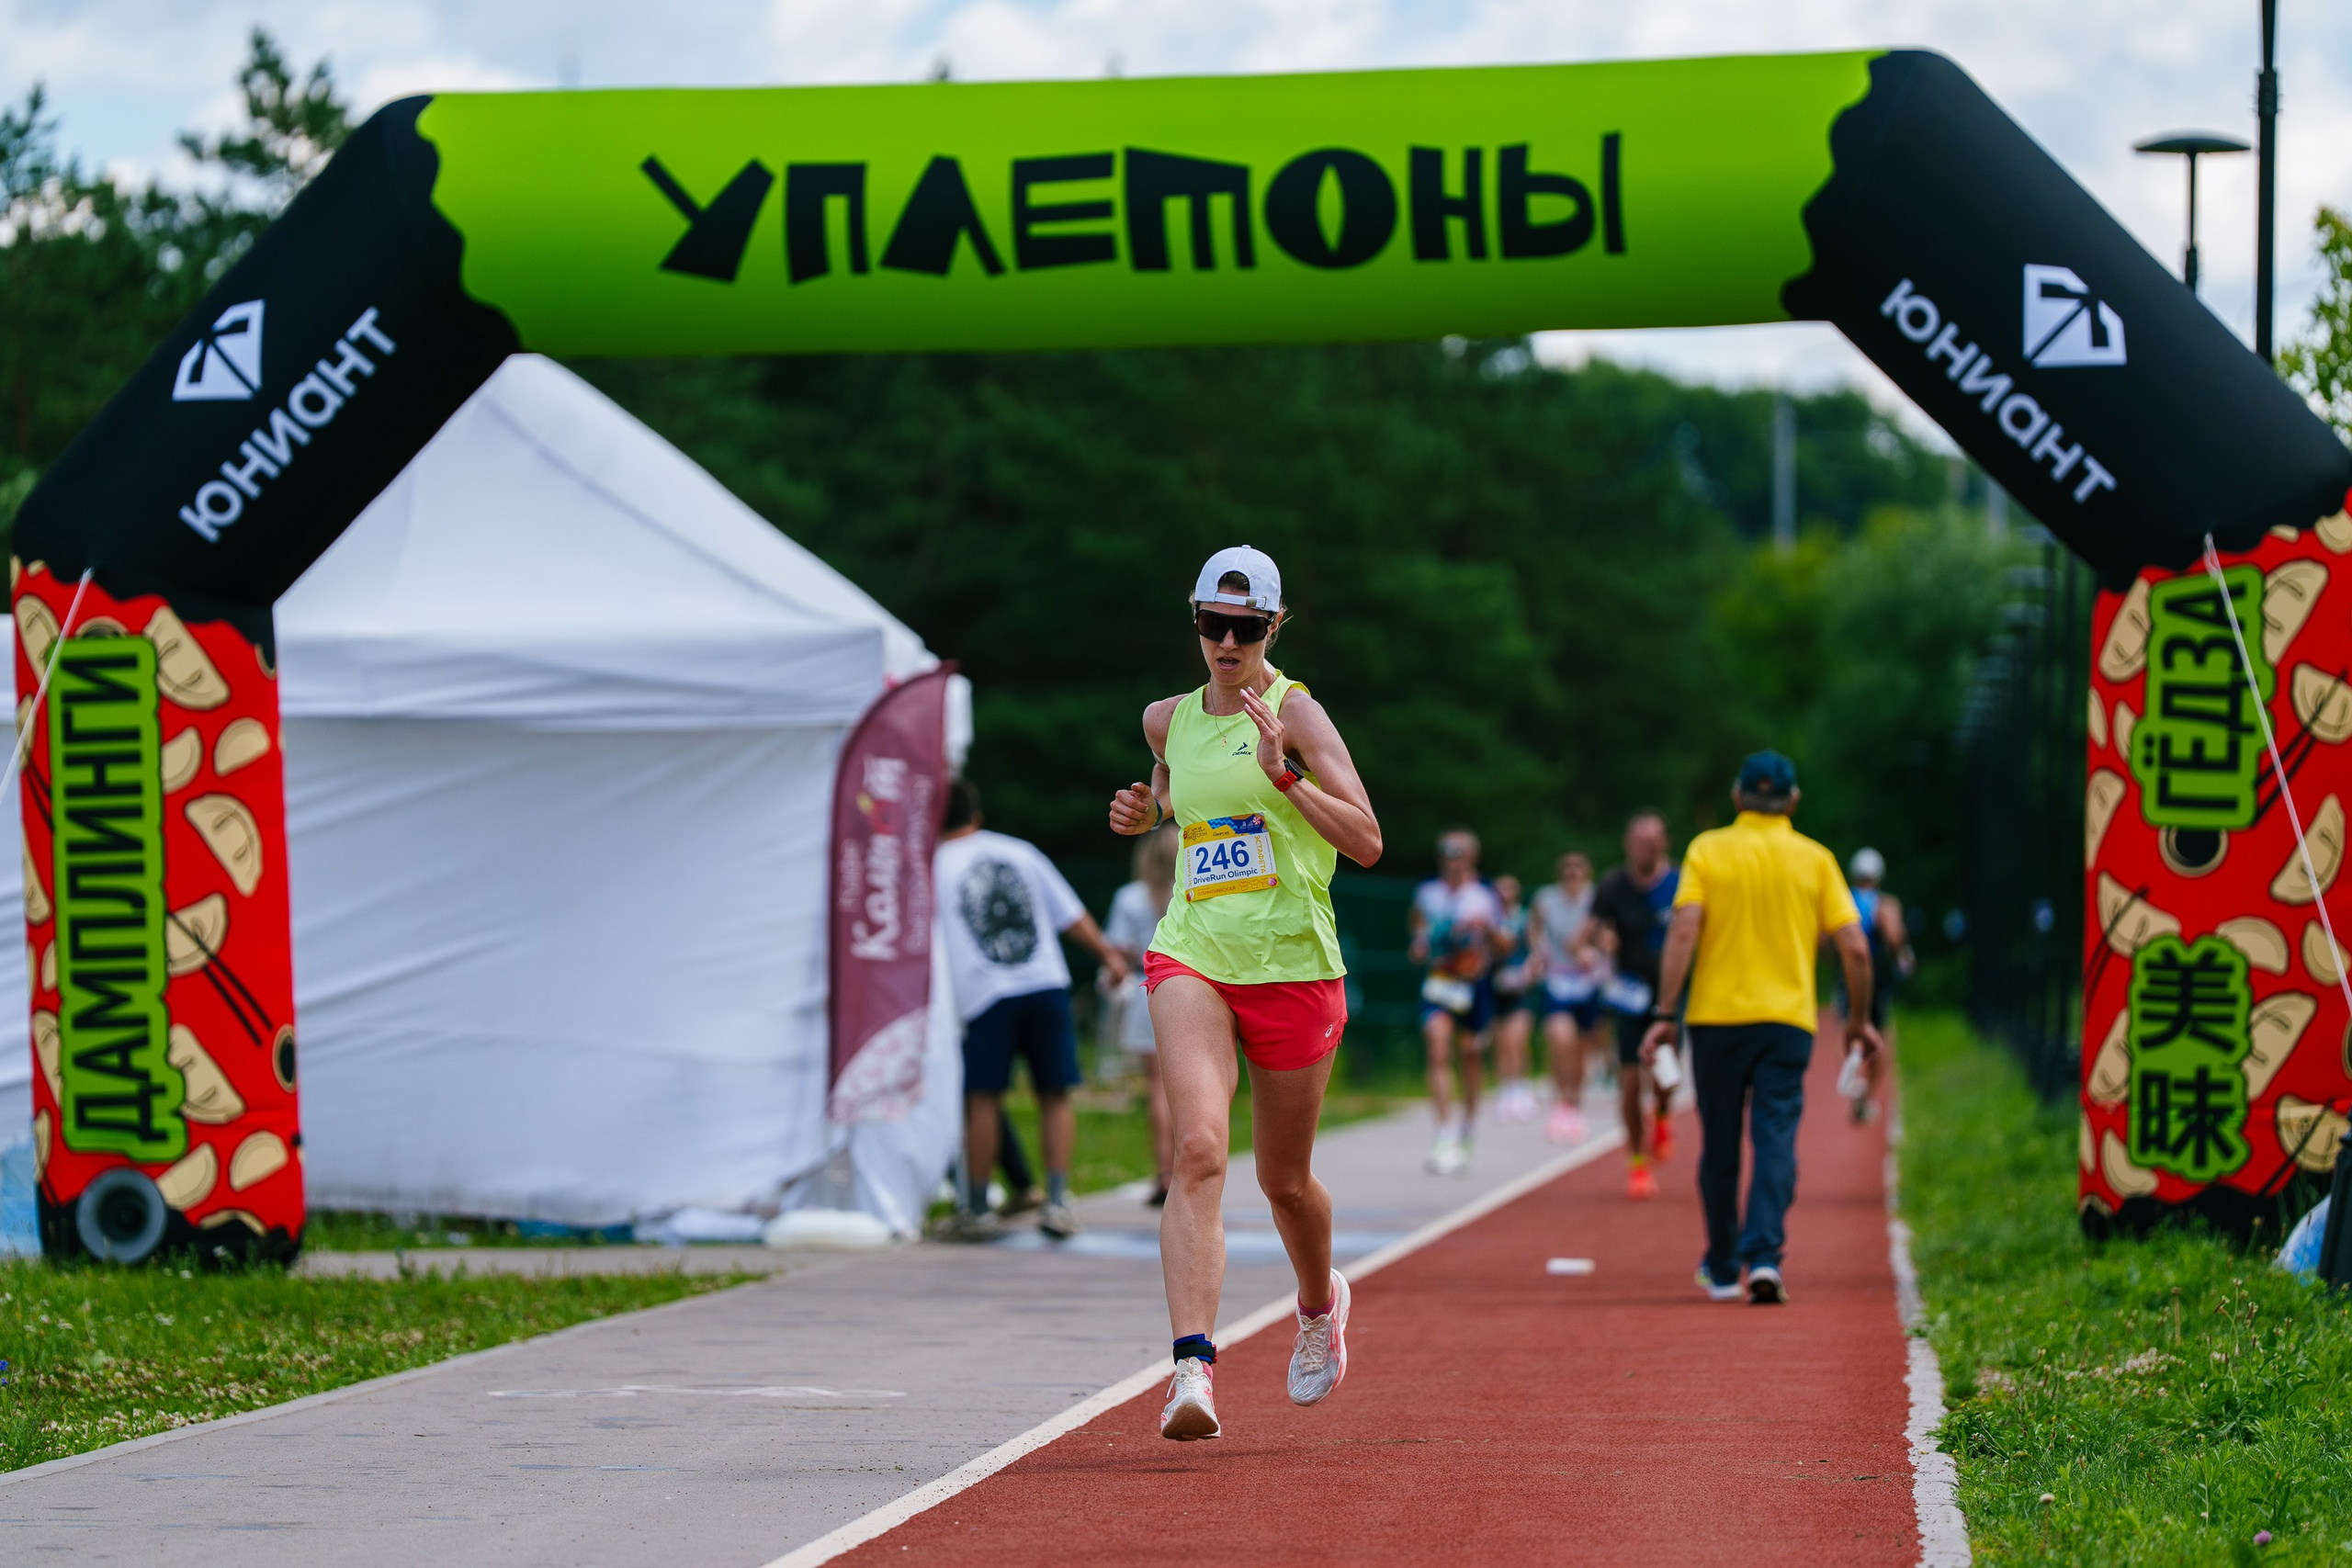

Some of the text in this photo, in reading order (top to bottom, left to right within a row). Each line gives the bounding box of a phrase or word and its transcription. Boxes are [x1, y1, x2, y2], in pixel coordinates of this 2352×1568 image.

[640, 130, 1627, 286] УПЛЕТОНЫ
[2143, 577, 2257, 813] ГЁДЗА
[60, 650, 169, 1143] ДАМПЛИНГИ
[1193, 867, 1259, 885] DriveRun Olimpic
[1195, 840, 1250, 874] 246
[1255, 835, 1266, 874] ЭСТАФЕТА
[2137, 945, 2240, 1169] 美味
